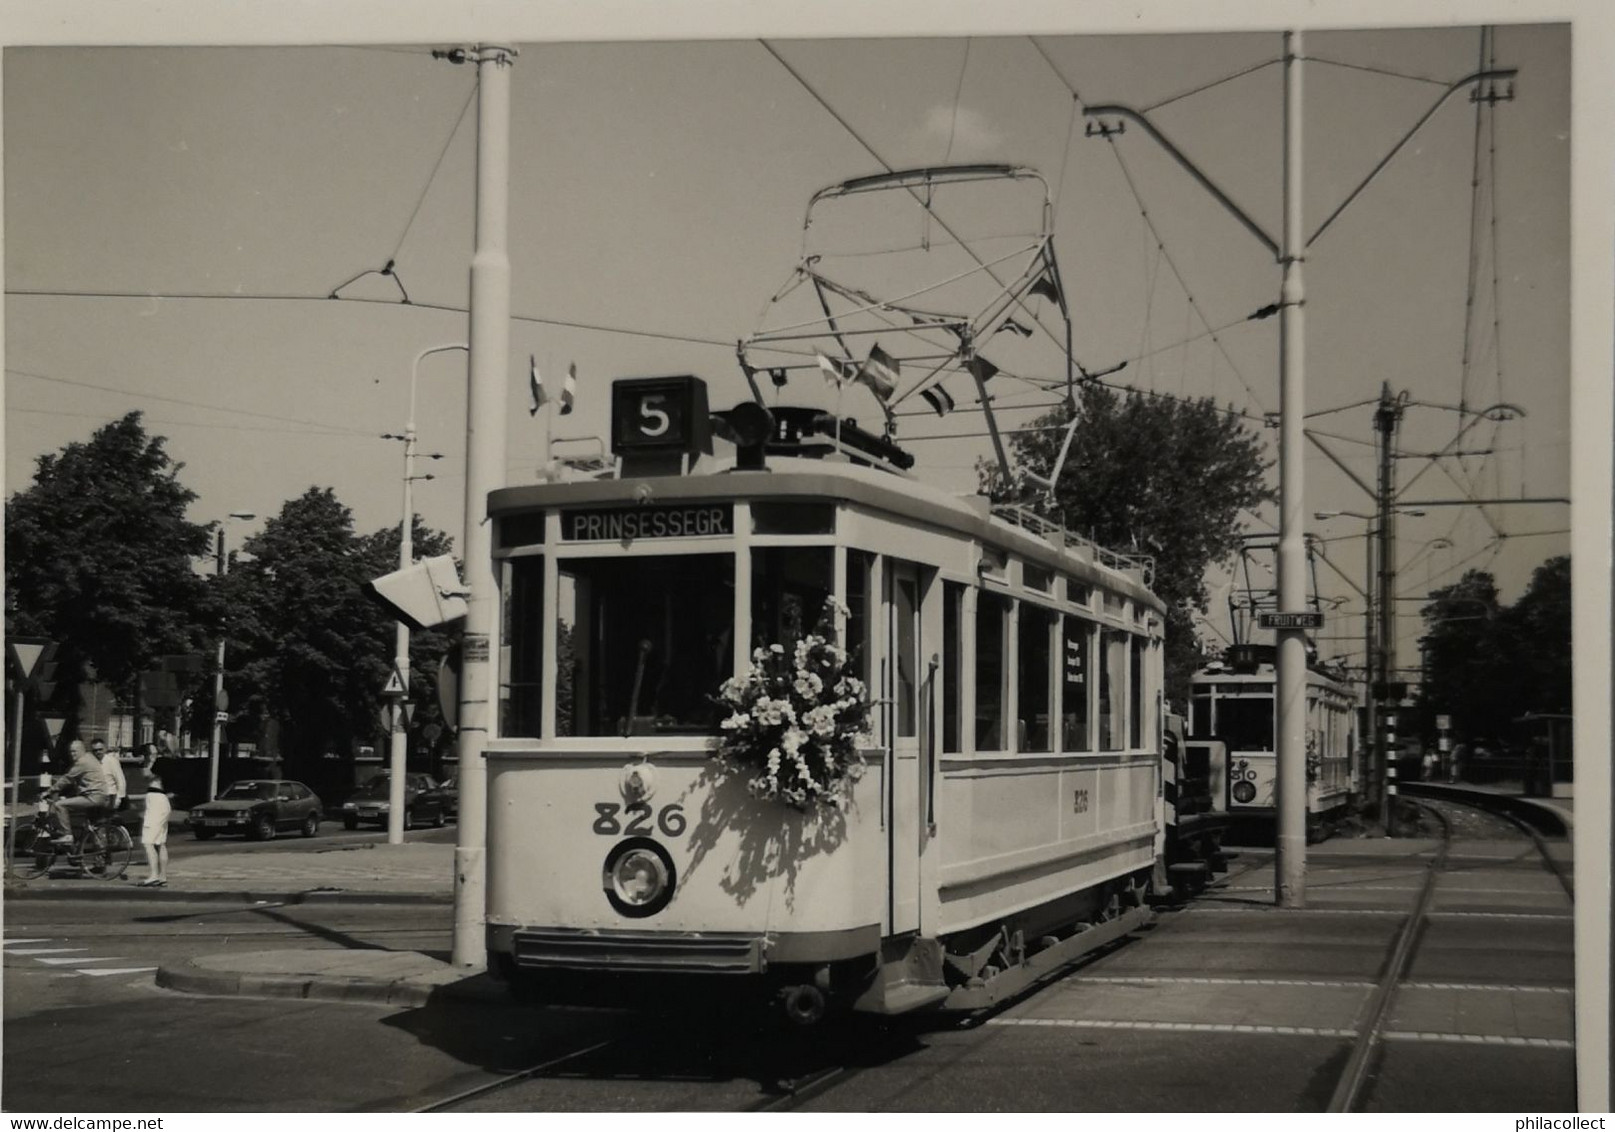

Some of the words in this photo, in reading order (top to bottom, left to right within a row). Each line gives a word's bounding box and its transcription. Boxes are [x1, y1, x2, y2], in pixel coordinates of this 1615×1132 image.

[640, 395, 670, 437] 5
[573, 508, 729, 541] PRINSESSEGR.
[1268, 614, 1315, 626] FRUITWEG
[592, 802, 687, 838] 826
